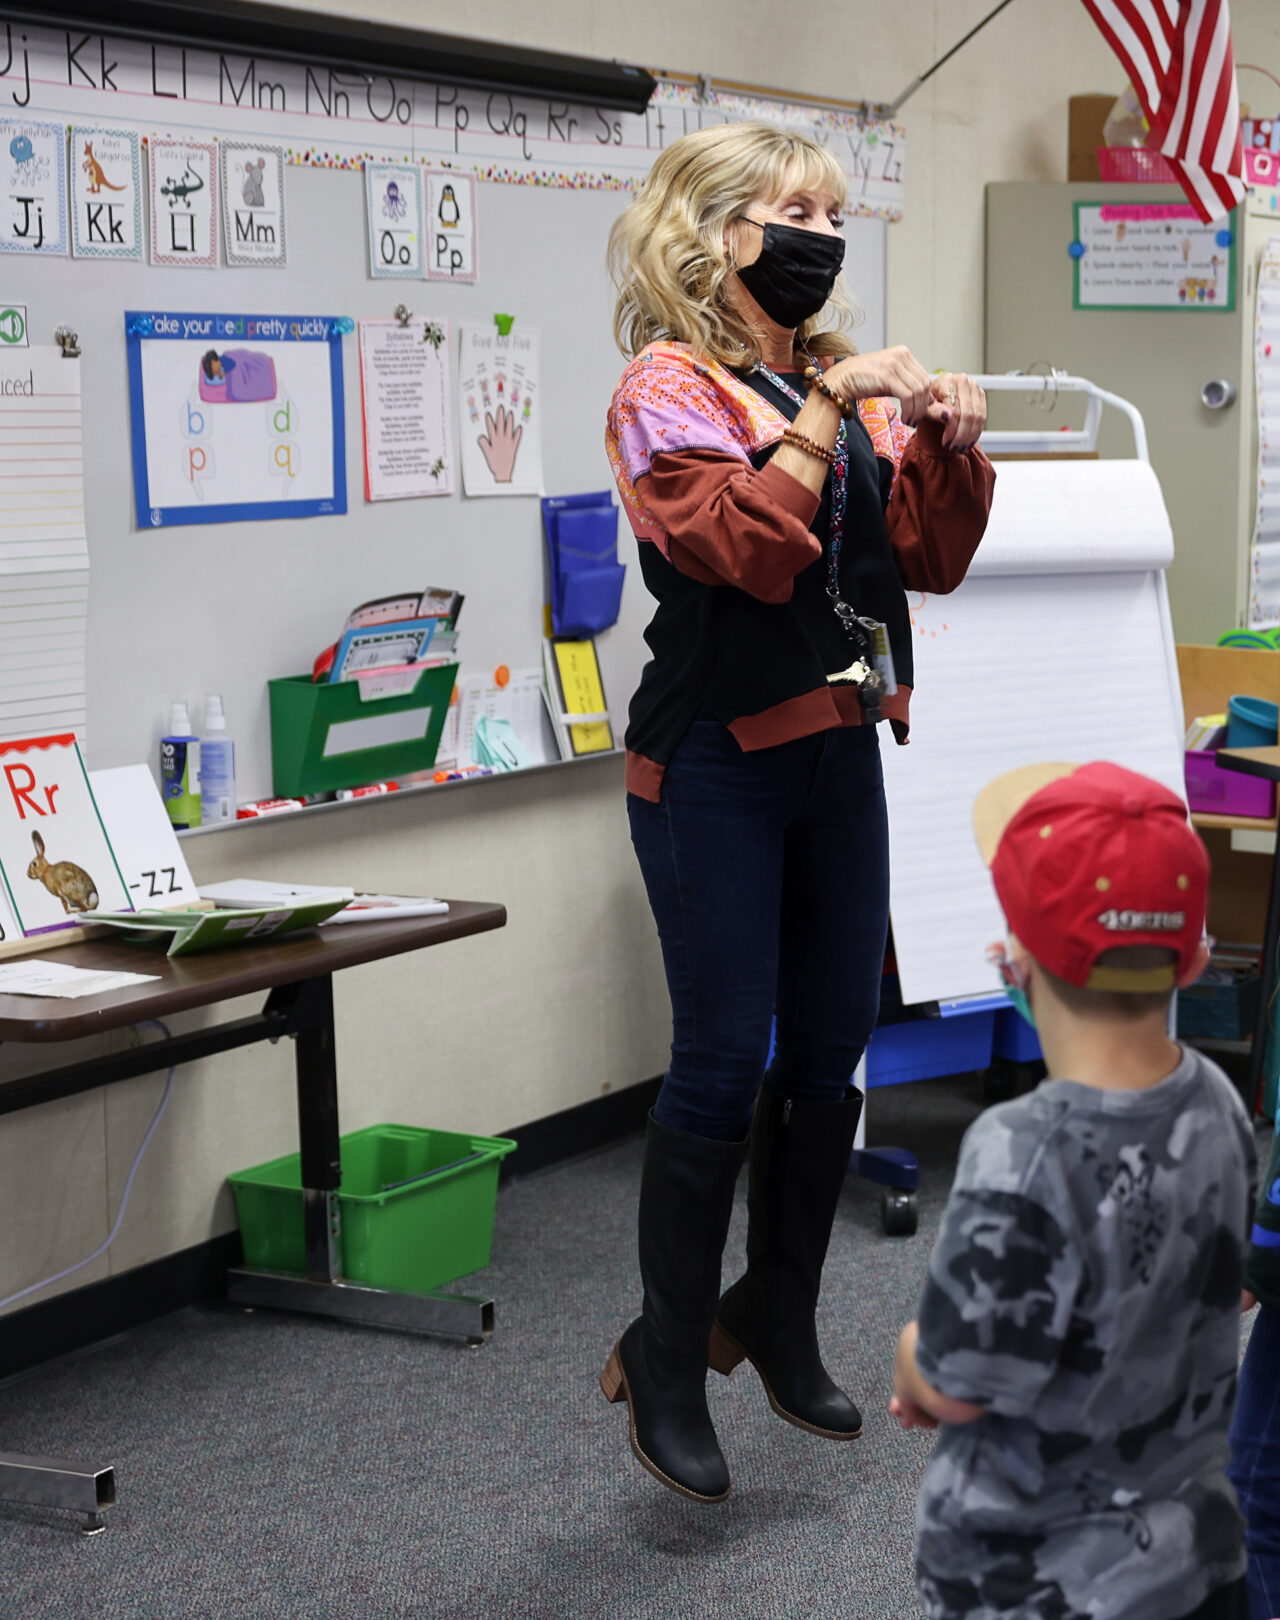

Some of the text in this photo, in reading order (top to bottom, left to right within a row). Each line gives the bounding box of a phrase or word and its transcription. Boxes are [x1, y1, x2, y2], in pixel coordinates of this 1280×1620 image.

[0, 23, 31, 107] Jj
[66, 32, 118, 91] Kk
[152, 45, 187, 100] Ll
[219, 54, 286, 113] Mm
[305, 66, 350, 119] Nn
[366, 76, 412, 125] Oo
[434, 84, 470, 154] Pp
[486, 92, 533, 161] Qq
[547, 101, 578, 144] Rr
[595, 108, 623, 146] Ss
[846, 134, 872, 196] Yy
[94, 150, 132, 163] Kangaroo
[13, 196, 44, 249] Jj
[86, 202, 125, 243] Kk
[170, 212, 196, 252] Ll
[234, 210, 276, 244] Mm
[381, 230, 411, 265] Oo
[436, 233, 463, 277] Pp
[151, 315, 330, 342] ake your bed pretty quickly
[186, 399, 291, 435] b d
[189, 444, 296, 483] p q
[4, 762, 60, 820] Rr
